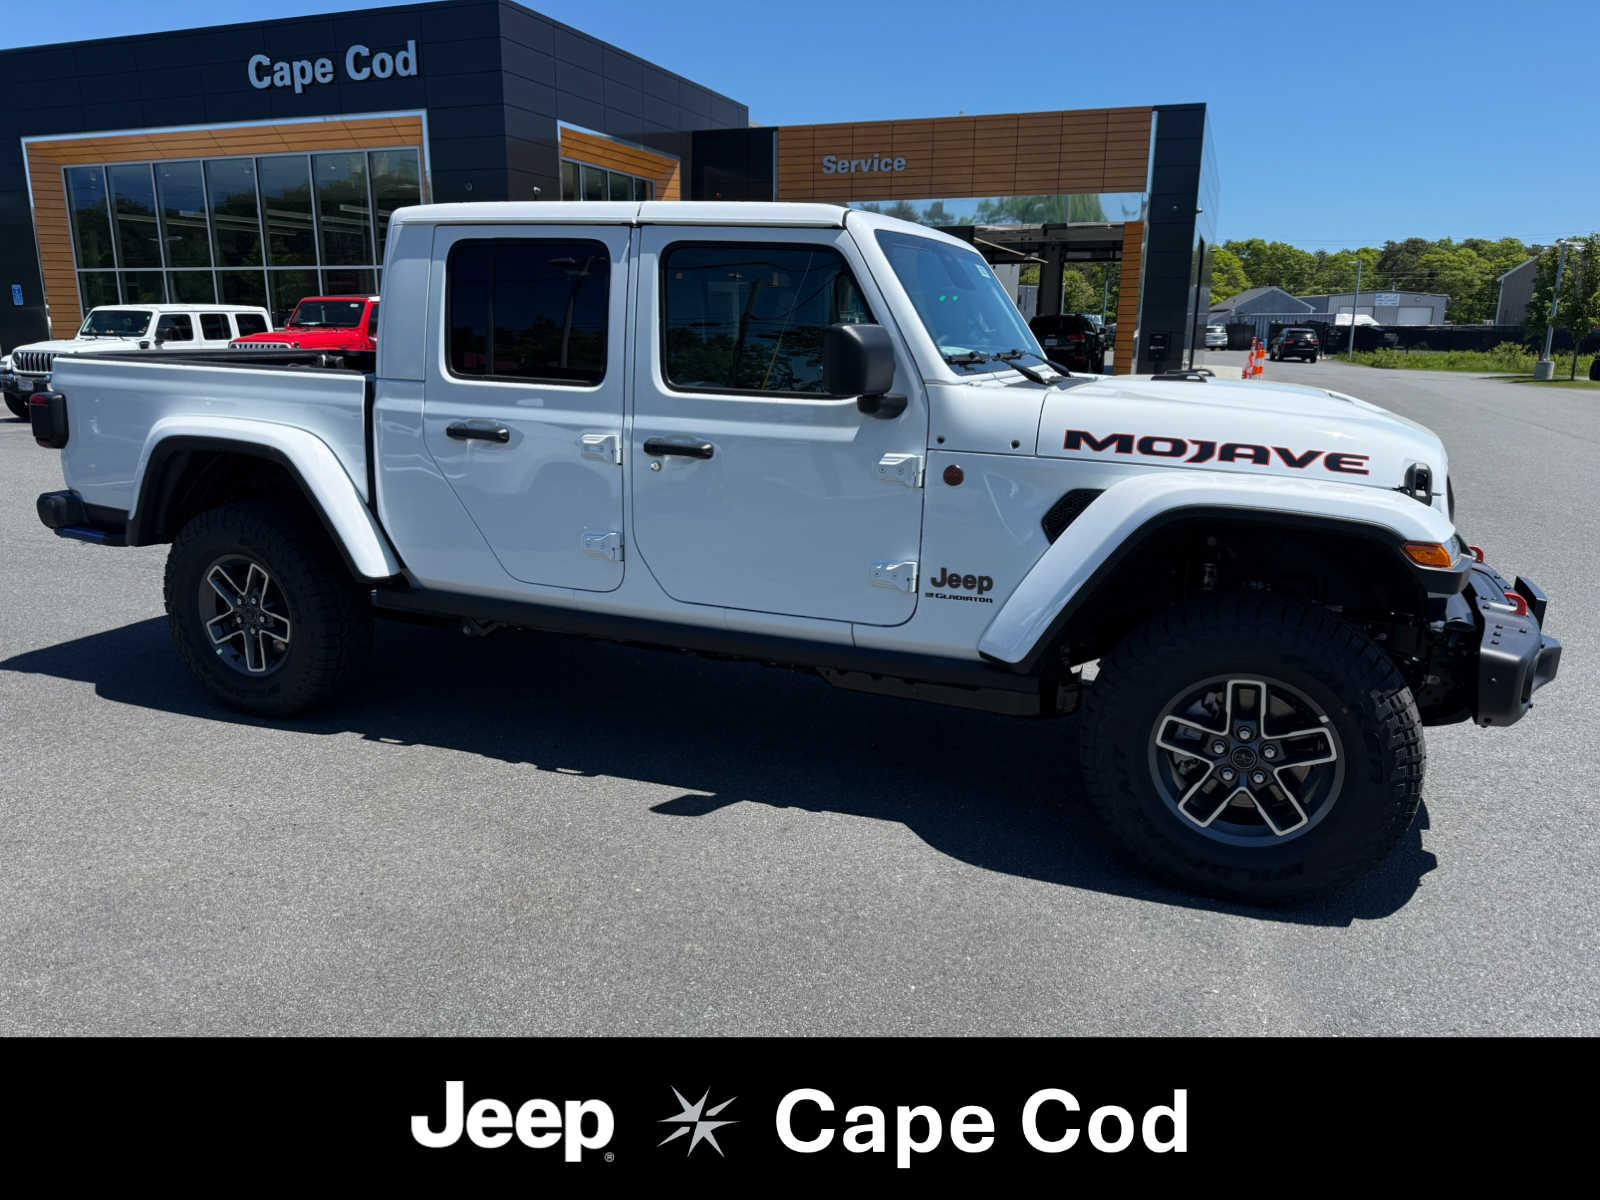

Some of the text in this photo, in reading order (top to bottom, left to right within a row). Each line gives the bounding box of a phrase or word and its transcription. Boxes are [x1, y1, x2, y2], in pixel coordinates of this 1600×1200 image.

[248, 39, 418, 94] Cape Cod
[822, 153, 907, 174] Service
[1063, 429, 1370, 475] MOJAVE
[930, 567, 993, 594] Jeep
[935, 592, 993, 604] GLADIATOR
